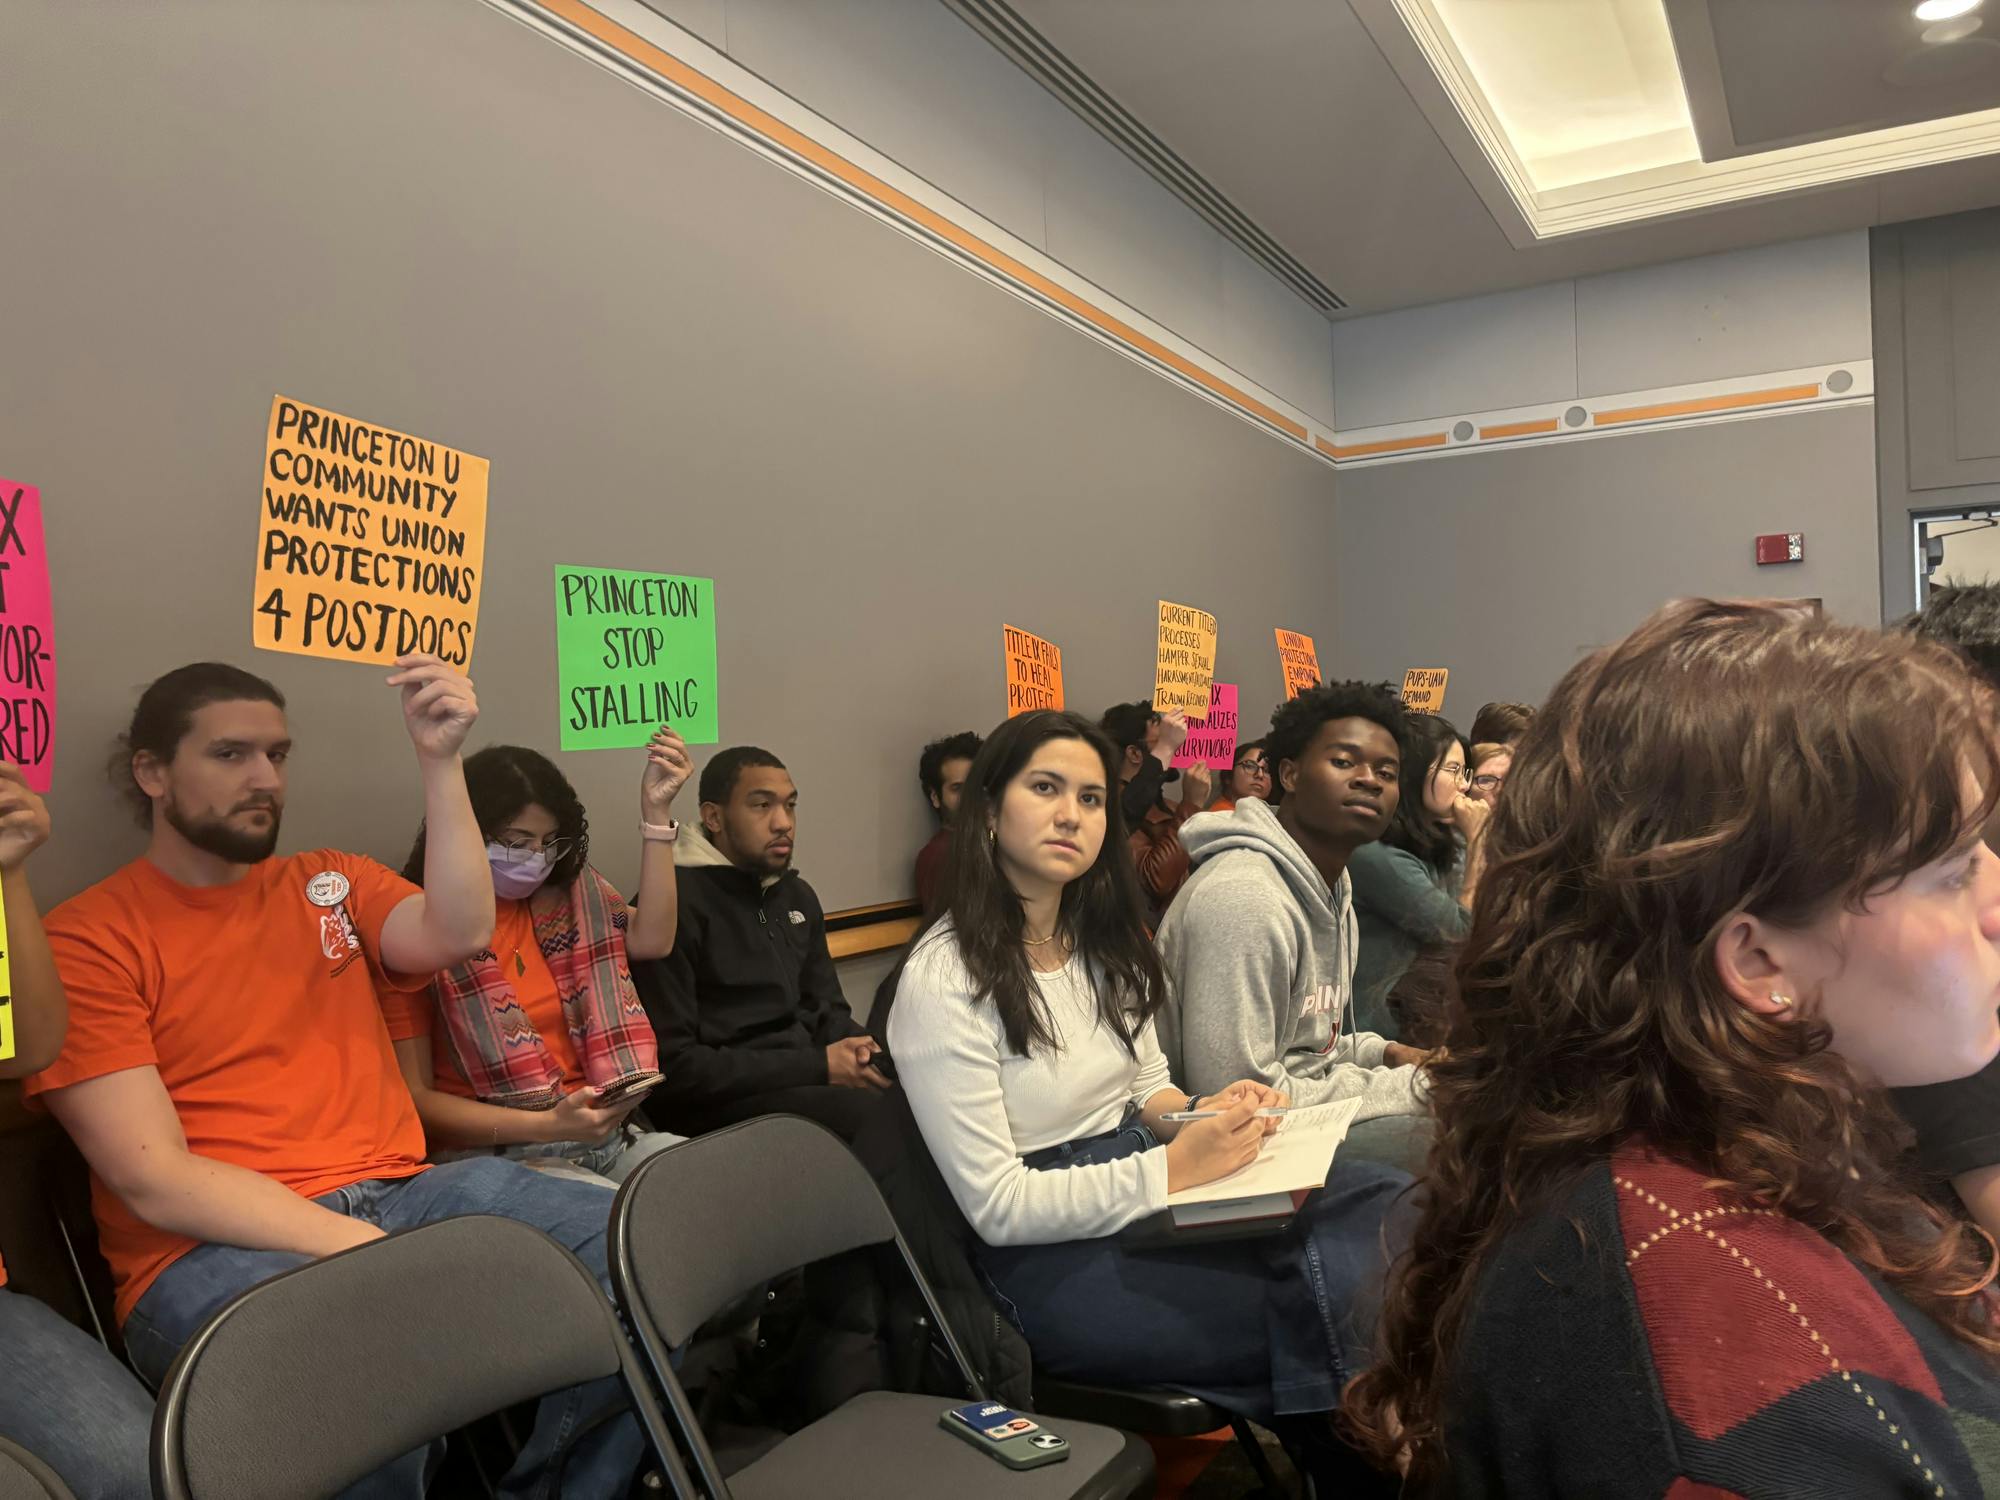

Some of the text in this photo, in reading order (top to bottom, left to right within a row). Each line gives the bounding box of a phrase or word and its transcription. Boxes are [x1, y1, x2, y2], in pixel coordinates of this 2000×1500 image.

[276, 403, 459, 484] PRINCETON U
[270, 449, 457, 518] COMMUNITY
[266, 488, 464, 558] WANTS UNION
[264, 529, 475, 604] PROTECTIONS
[561, 574, 698, 618] PRINCETON
[1161, 605, 1197, 628] CURRENT
[257, 588, 471, 665] 4 POSTDOCS
[1005, 629, 1032, 658] TITLE
[1160, 625, 1201, 649] PROCESSES
[603, 628, 664, 669] STOP
[1159, 648, 1211, 670] HAMPER SEXUAL
[1014, 658, 1054, 691] TO HEAL
[570, 678, 698, 730] STALLING
[1402, 690, 1431, 704] DEMAND
